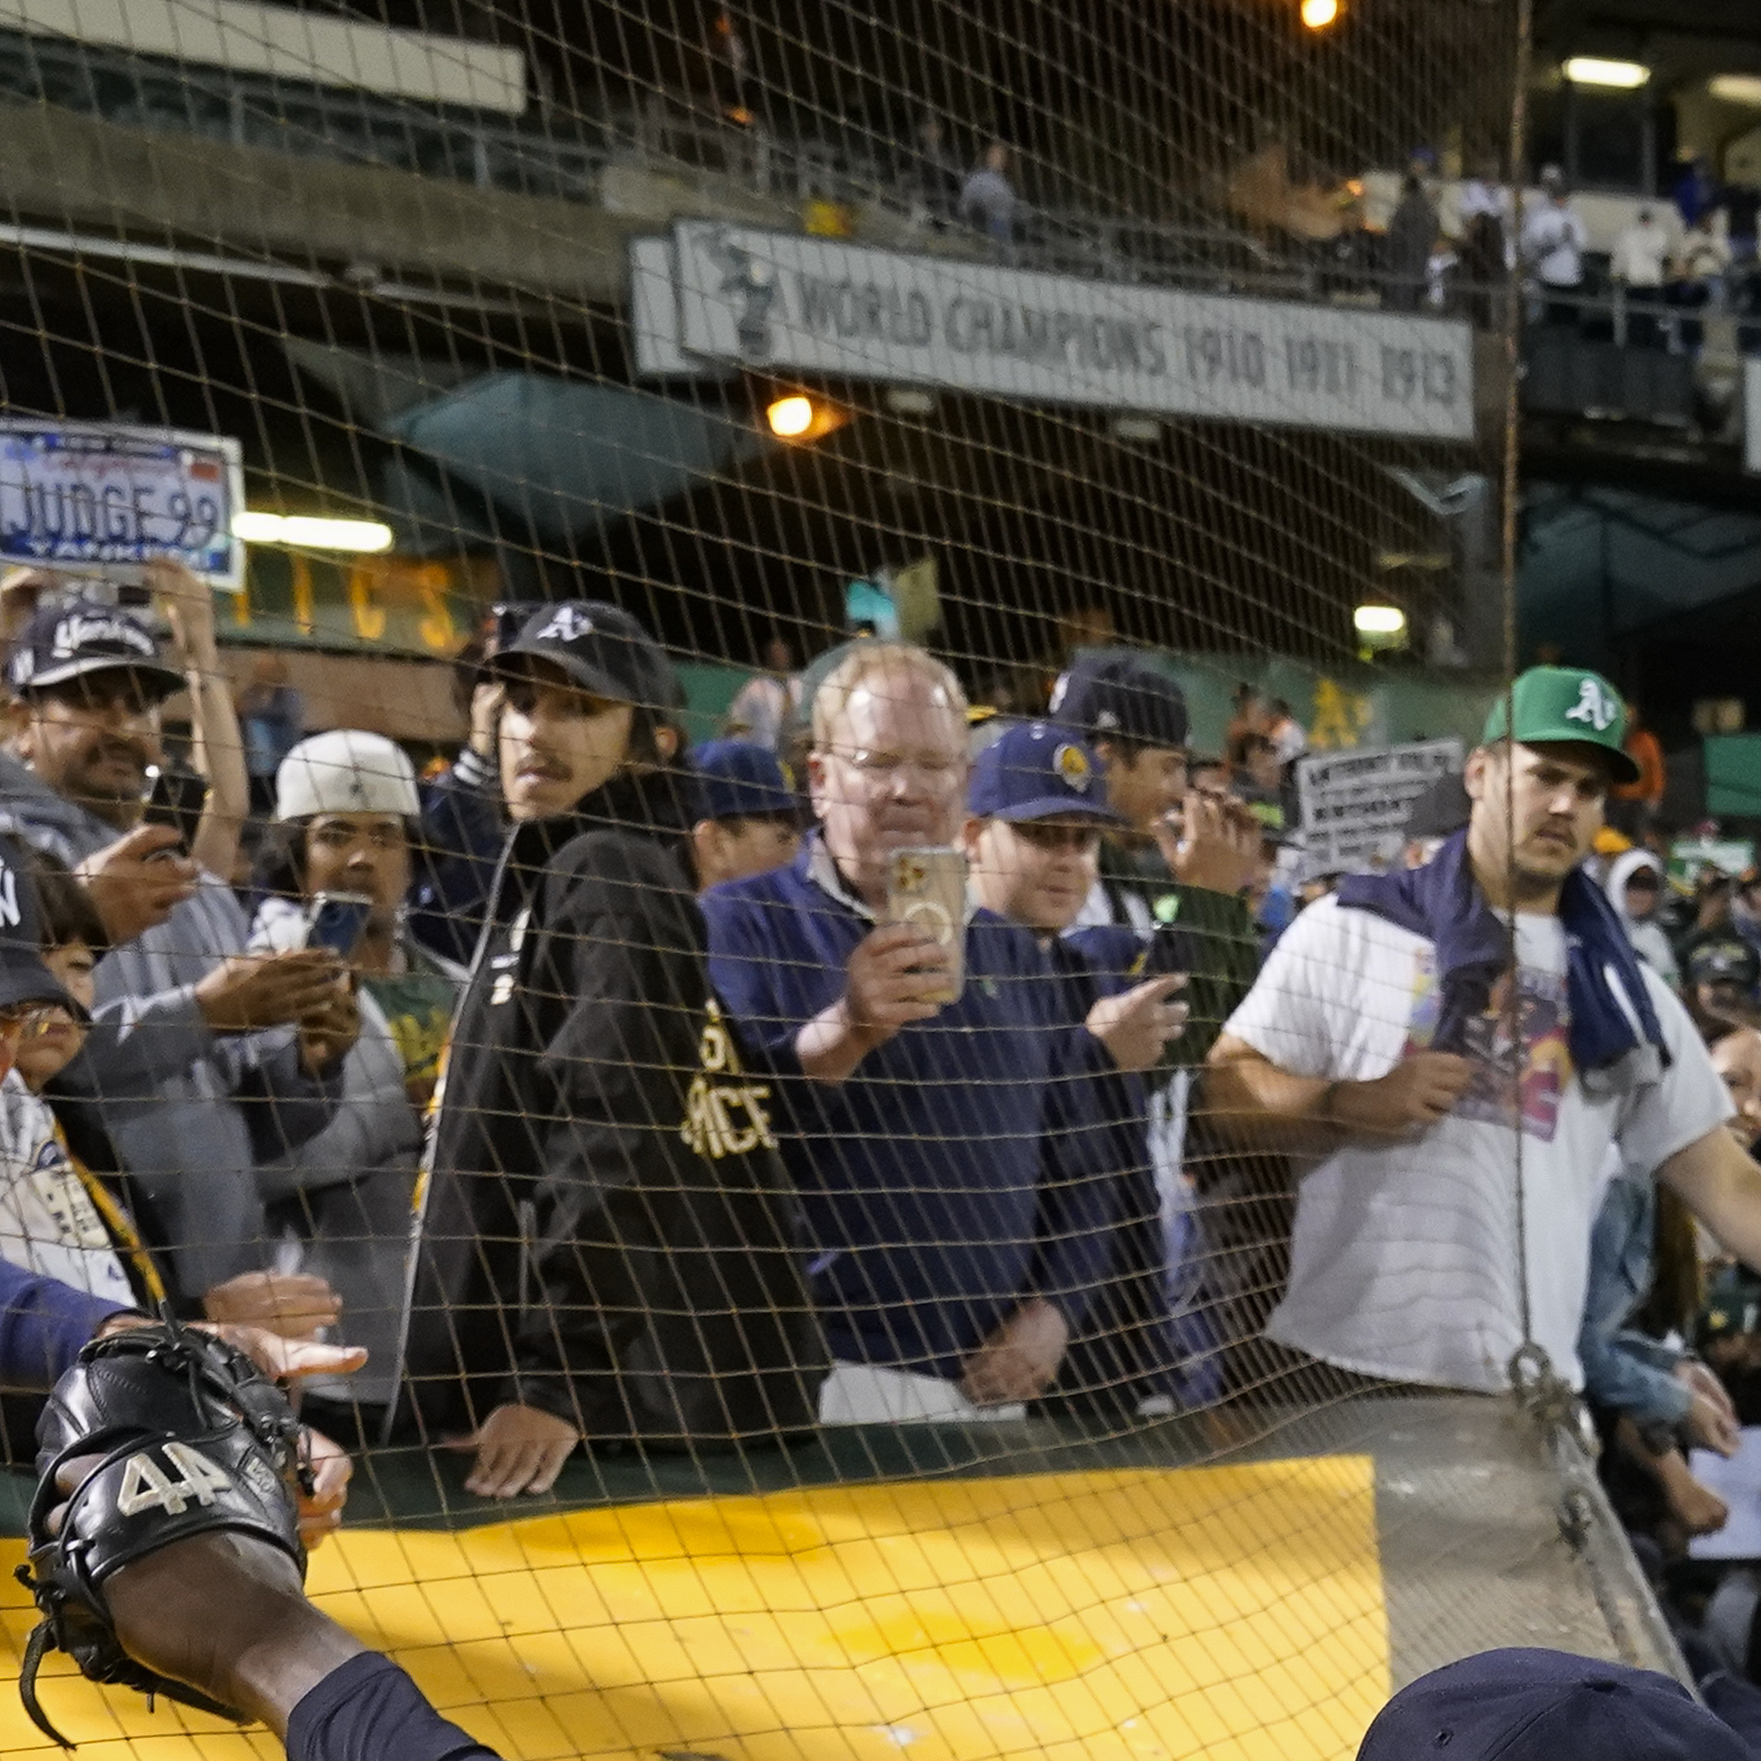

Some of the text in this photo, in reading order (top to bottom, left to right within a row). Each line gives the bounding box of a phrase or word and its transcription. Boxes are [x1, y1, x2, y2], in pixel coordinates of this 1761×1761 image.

[793, 272, 931, 347] WORLD
[944, 294, 1167, 378] CHAMPIONS
[166, 490, 218, 550] 99
[117, 1442, 233, 1517] 44
